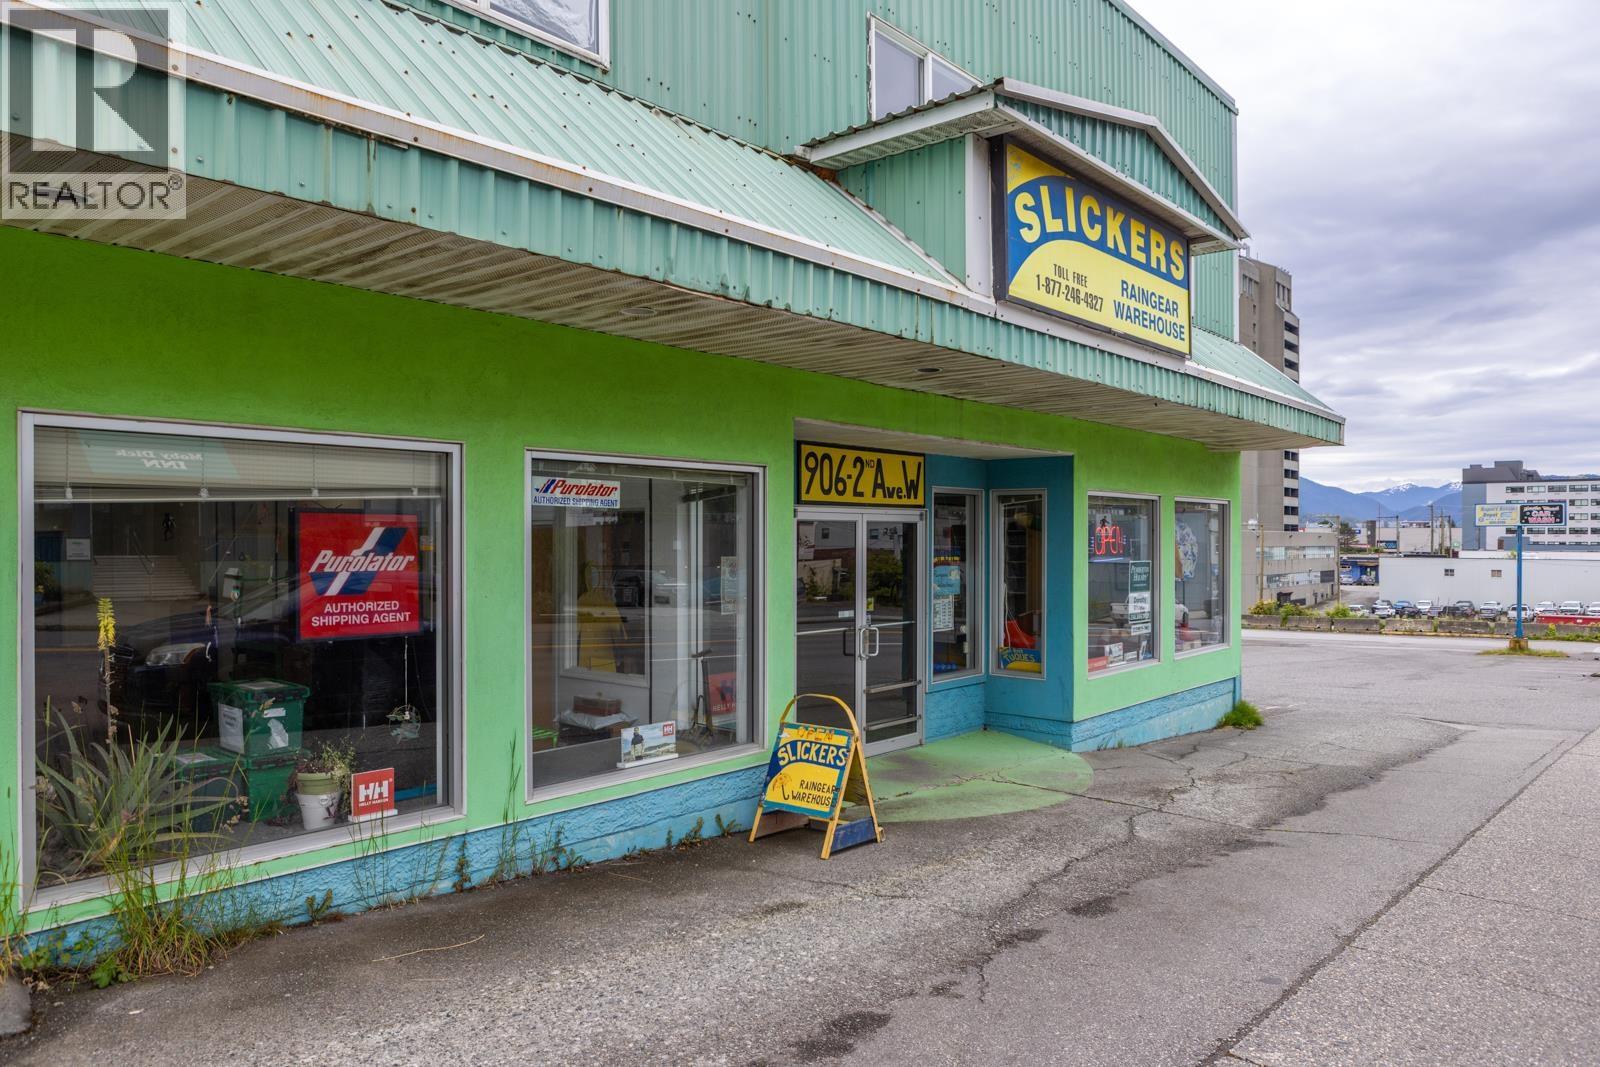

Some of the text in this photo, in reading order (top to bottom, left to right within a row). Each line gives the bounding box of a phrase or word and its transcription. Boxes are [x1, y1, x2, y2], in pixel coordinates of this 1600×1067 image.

[1014, 185, 1185, 281] SLICKERS
[1053, 263, 1089, 288] TOLL FREE
[1036, 274, 1104, 312] 1-877-246-4327
[1120, 279, 1179, 318] RAINGEAR
[1113, 299, 1186, 341] WAREHOUSE
[550, 480, 618, 497] Purolator
[533, 496, 618, 507] AUTHORIZED SHIPPING AGENT
[309, 549, 415, 574] Purolator
[312, 612, 411, 627] SHIPPING AGENT
[324, 601, 400, 613] AUTHORIZED
[777, 741, 849, 766] SLICKERS
[359, 780, 389, 802] HH
